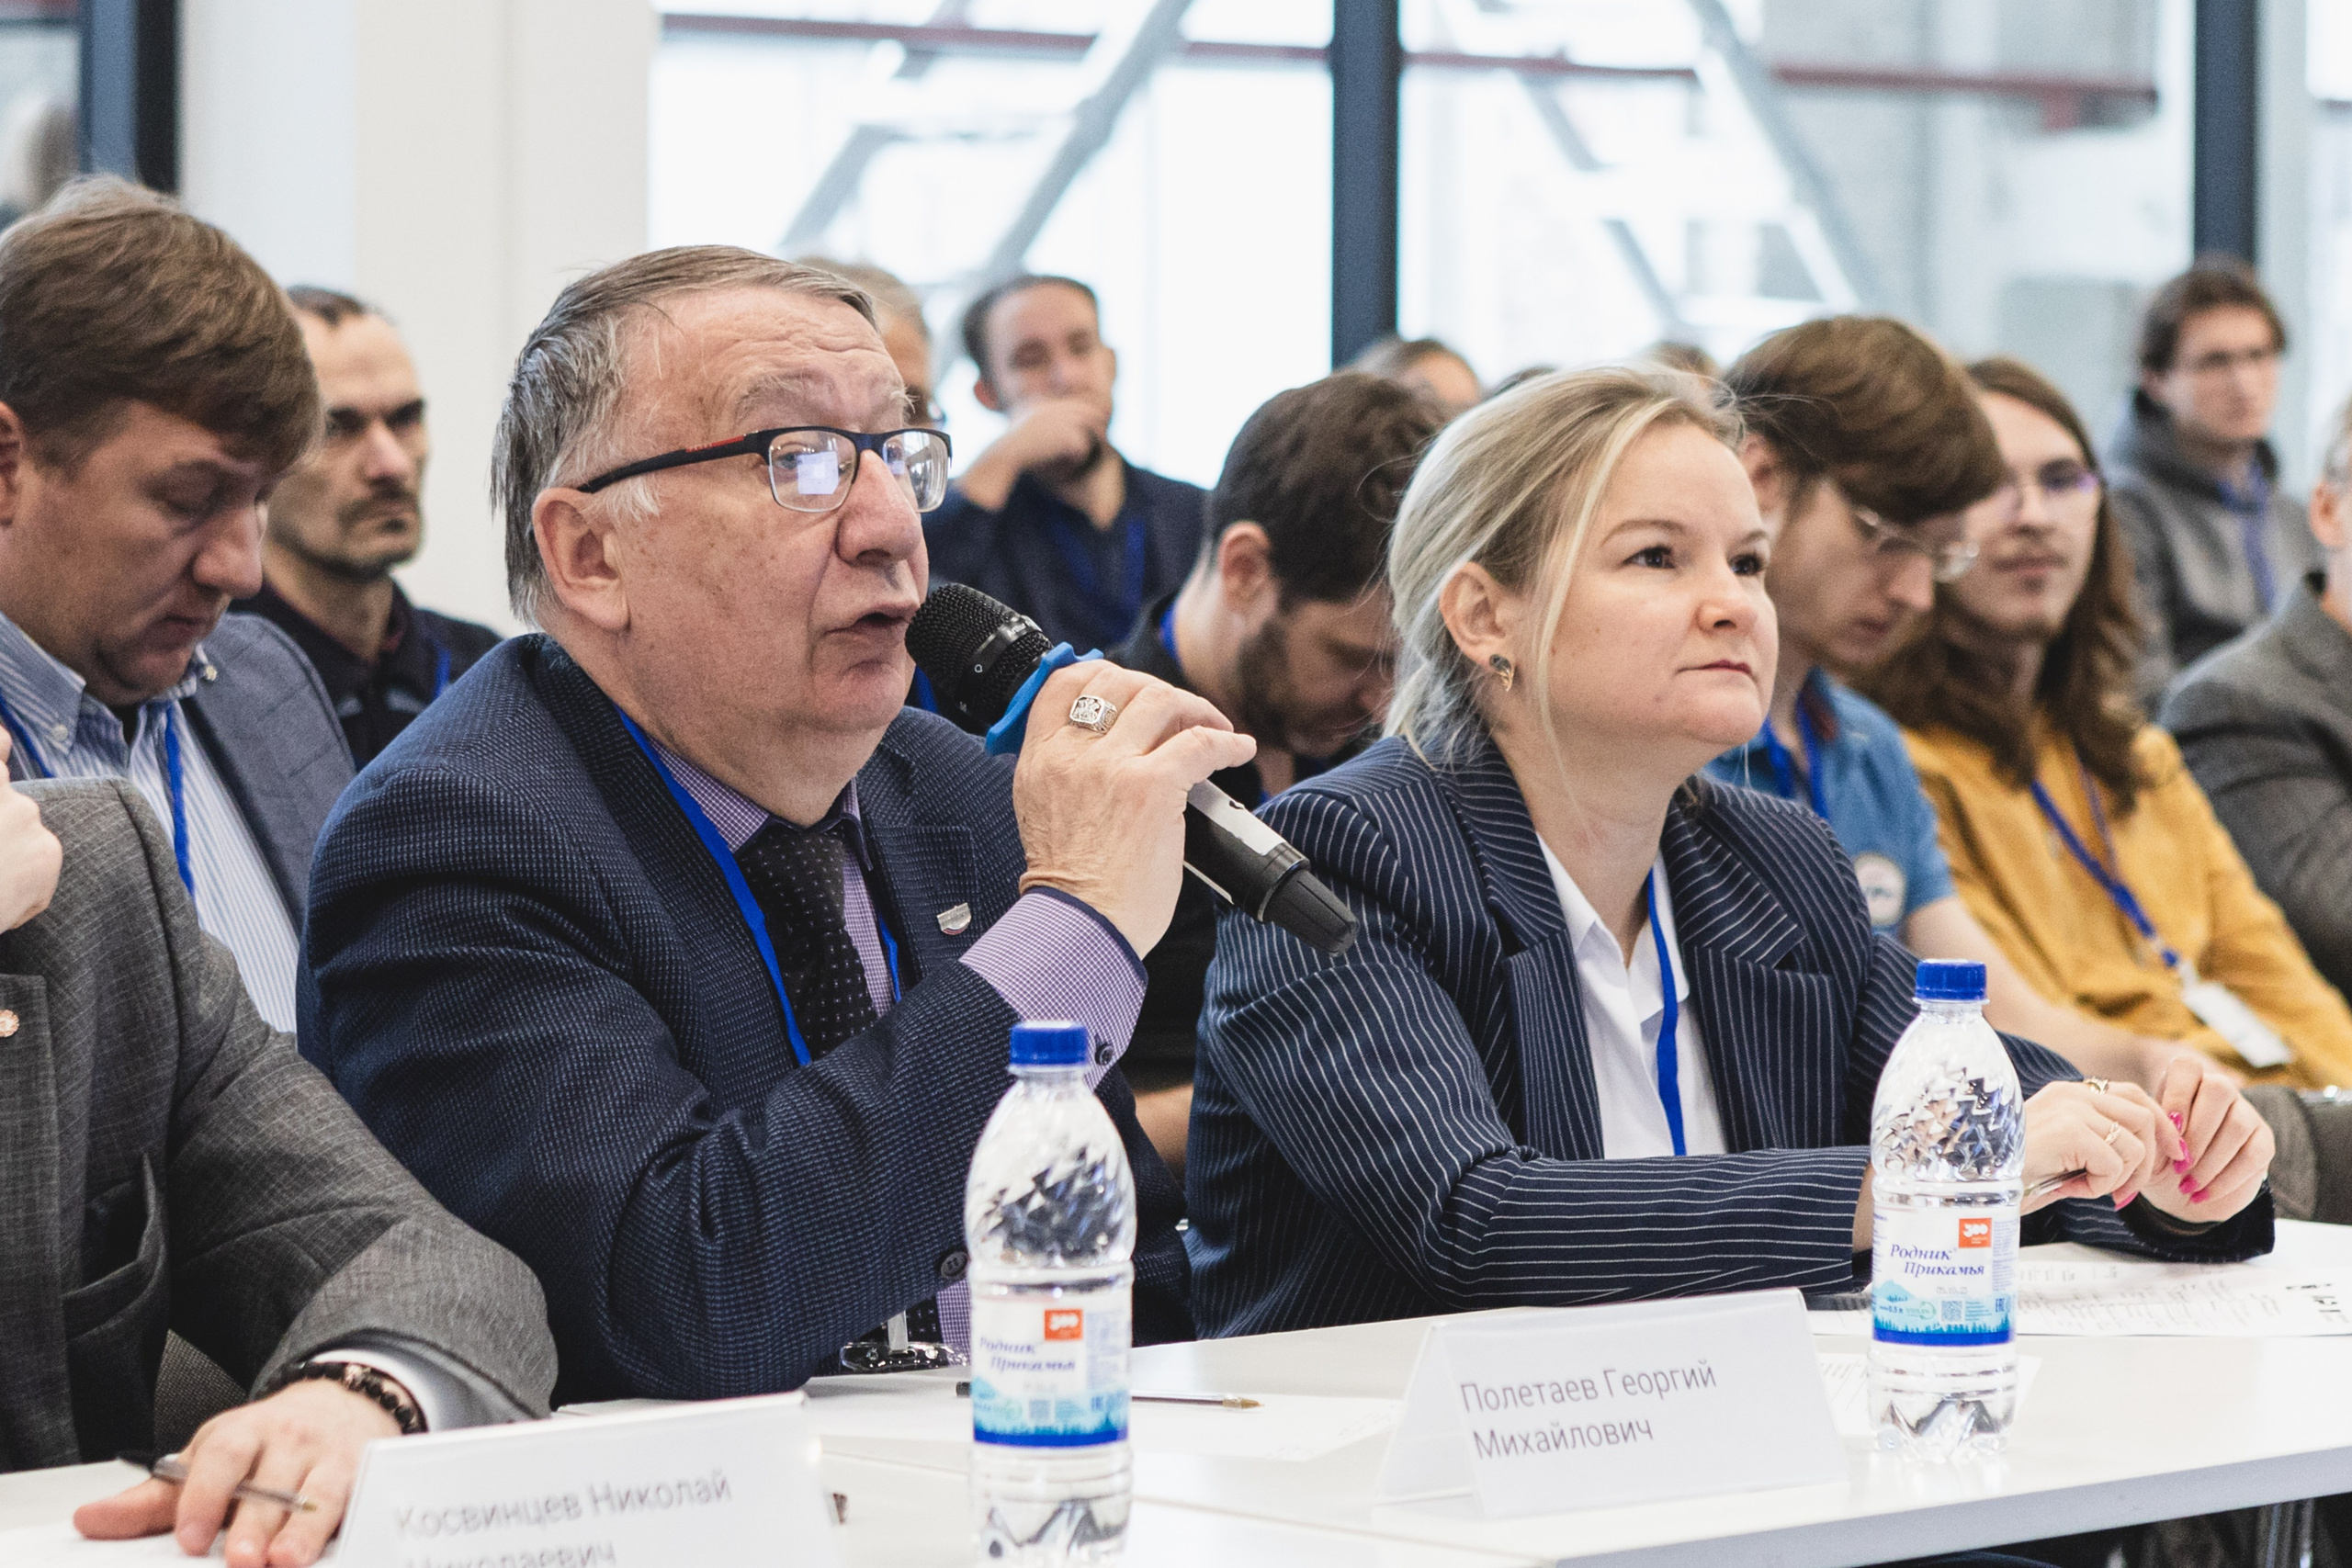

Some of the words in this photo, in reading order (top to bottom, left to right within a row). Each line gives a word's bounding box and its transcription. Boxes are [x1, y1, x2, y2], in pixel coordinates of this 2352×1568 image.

[1890, 1243, 1952, 1261] Родник
[1904, 1261, 1985, 1279] Прикамья
[1460, 1377, 1600, 1414] Полетаев
[1602, 1359, 1717, 1401] Георгий
[1473, 1419, 1655, 1461] Михайлович
[394, 1490, 583, 1541] Косвинцев
[590, 1468, 733, 1516] Николай
